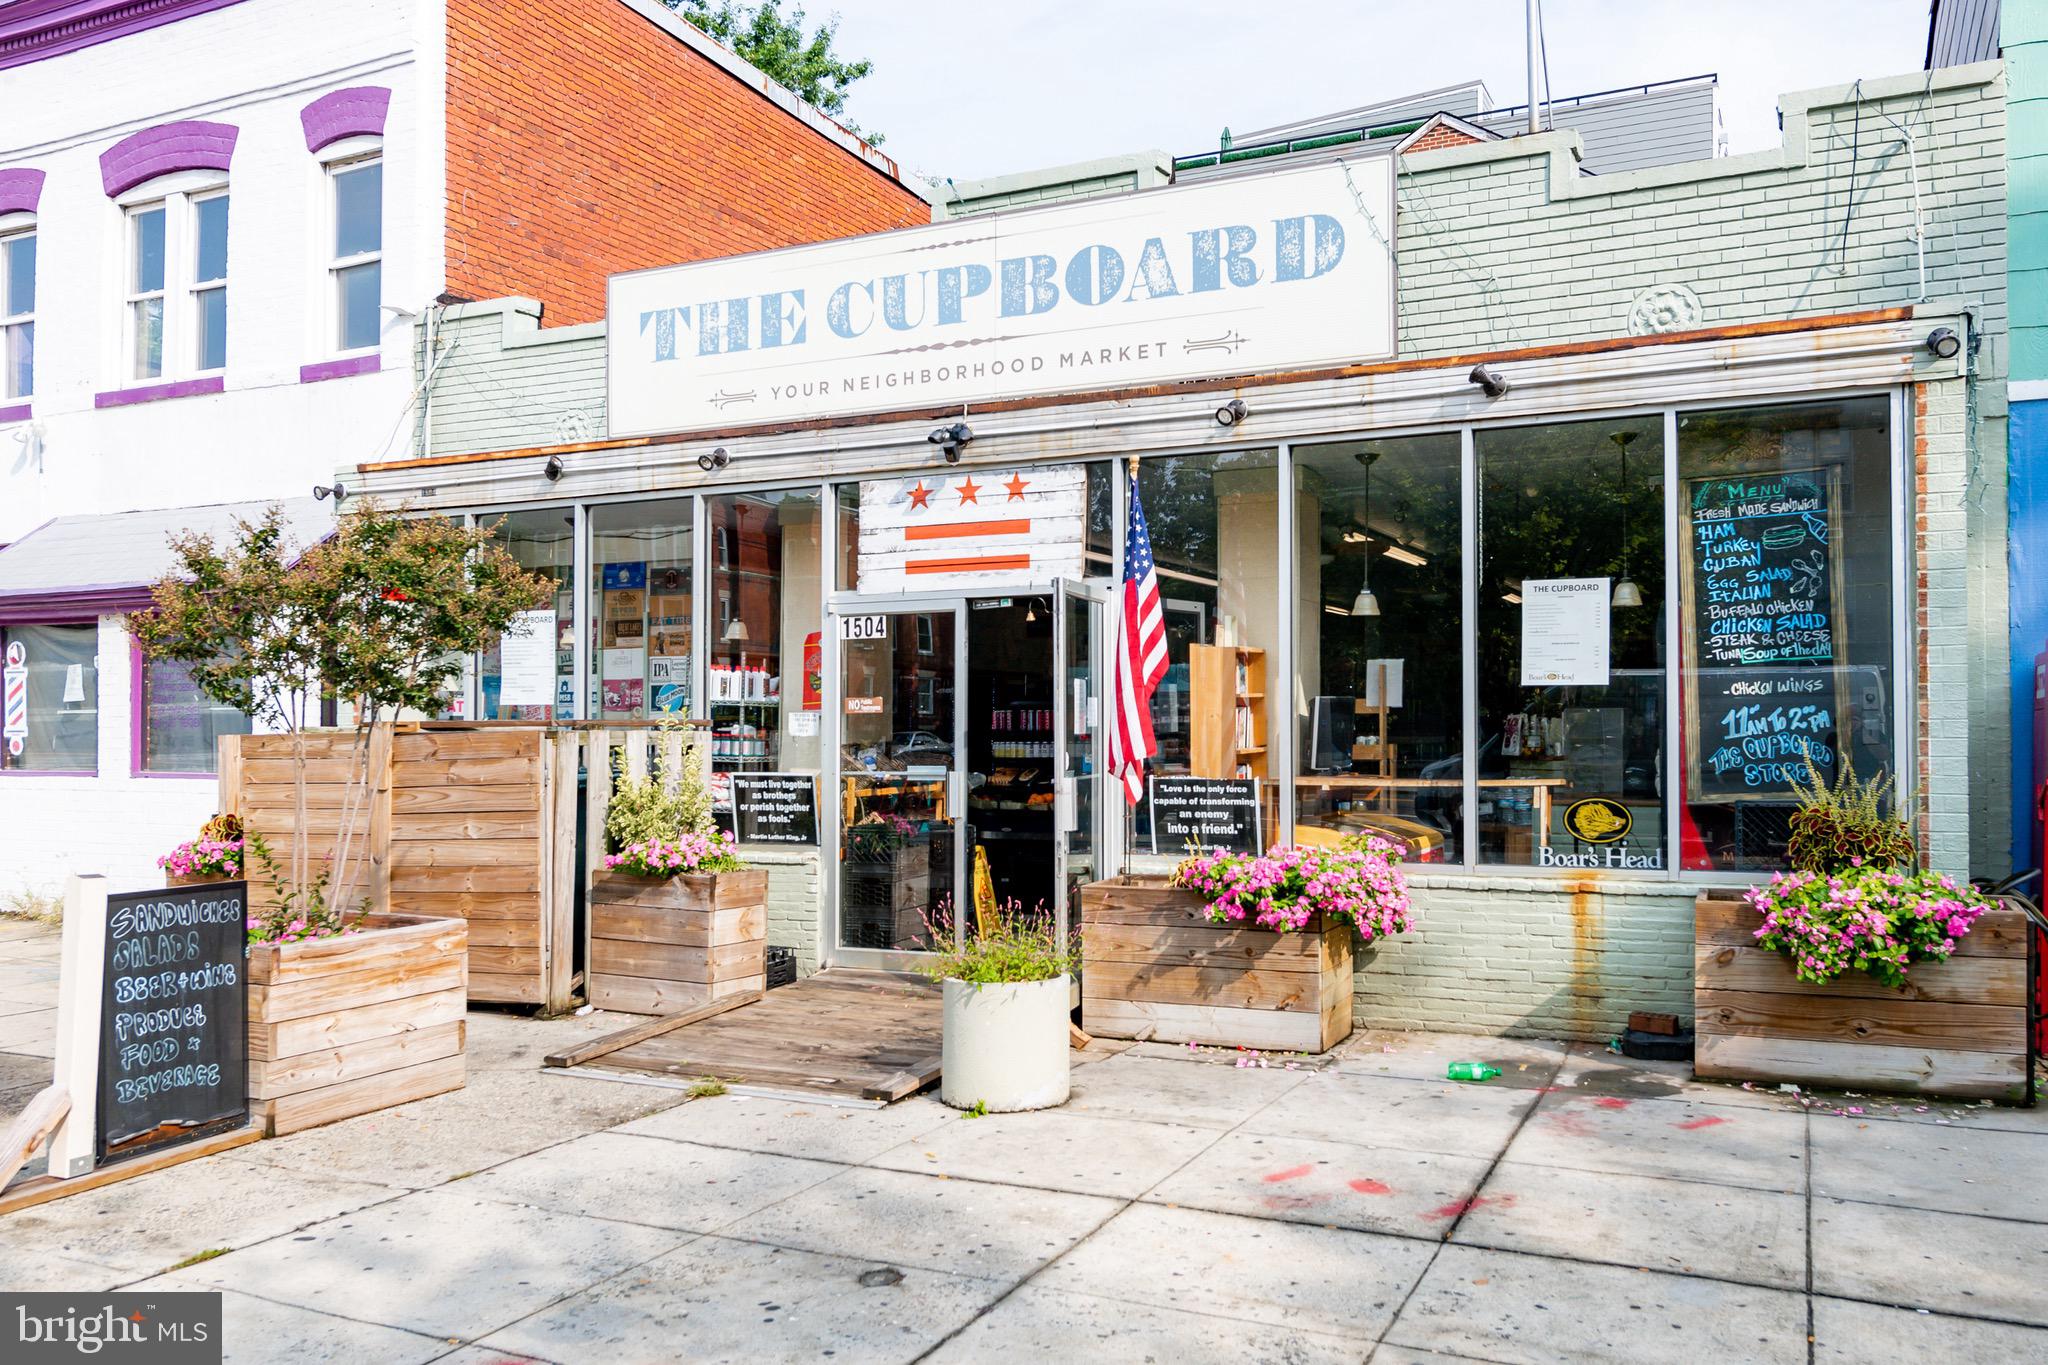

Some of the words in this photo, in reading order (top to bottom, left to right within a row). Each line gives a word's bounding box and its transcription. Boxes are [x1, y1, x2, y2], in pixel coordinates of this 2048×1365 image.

[638, 288, 808, 363] THE
[824, 212, 1348, 340] CUPBOARD
[769, 380, 832, 402] YOUR
[841, 354, 1045, 393] NEIGHBORHOOD
[1058, 341, 1168, 370] MARKET
[1694, 506, 1731, 521] FRESH
[1738, 502, 1769, 517] MADE
[1703, 555, 1761, 572] CUBAN
[1533, 585, 1550, 593] THE
[1551, 583, 1600, 593] CUPBOARD
[1706, 574, 1739, 590] EGG
[1746, 567, 1792, 582] SALAD
[843, 616, 885, 638] 1504
[1776, 613, 1827, 632] SALAD
[1762, 634, 1775, 646] &
[1776, 629, 1831, 646] CHEESE
[654, 663, 669, 676] IPA
[848, 699, 861, 711] NO
[1708, 747, 1744, 775] THE
[1744, 762, 1812, 786] STORE
[750, 780, 768, 789] must
[769, 780, 781, 789] live
[782, 780, 812, 791] together
[1183, 785, 1191, 793] is
[1193, 784, 1206, 793] the
[1207, 785, 1225, 795] only
[1226, 785, 1248, 793] force
[752, 792, 762, 800] as
[763, 791, 797, 800] brothers
[1153, 797, 1187, 807] capable
[1189, 797, 1198, 805] of
[1199, 797, 1256, 807] transforming
[750, 803, 775, 812] perish
[775, 803, 810, 813] together
[1194, 811, 1229, 820] enemy
[1167, 823, 1190, 834] into
[1191, 825, 1199, 833] a
[1538, 846, 1600, 867] Boar's
[1604, 847, 1662, 869] Head
[113, 931, 200, 971] SALADS
[116, 1004, 207, 1041] PRODUCE
[120, 1037, 179, 1070] FOOD
[115, 1063, 221, 1103] BEVERAGE
